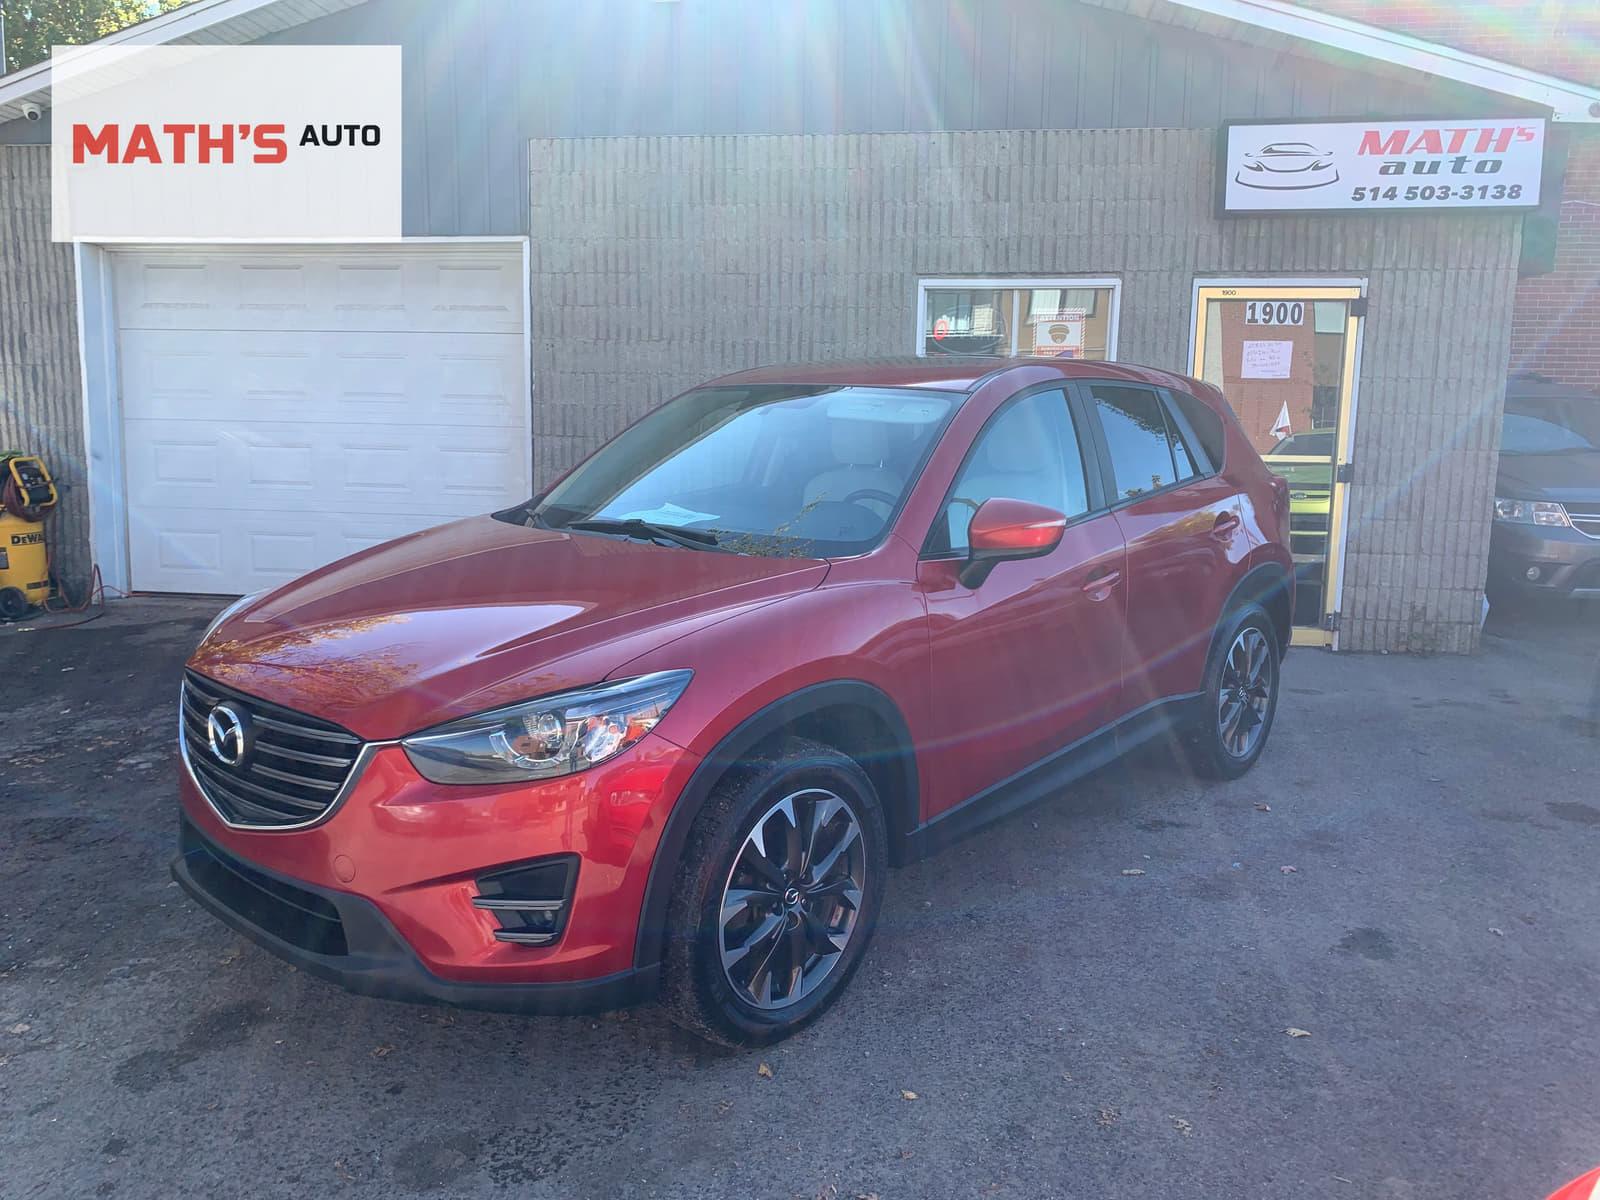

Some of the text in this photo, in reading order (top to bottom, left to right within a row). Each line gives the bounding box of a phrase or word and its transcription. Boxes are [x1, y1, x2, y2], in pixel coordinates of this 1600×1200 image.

[1379, 155, 1503, 176] auto
[1351, 184, 1523, 202] 514 503-3138
[1247, 302, 1303, 324] 1900
